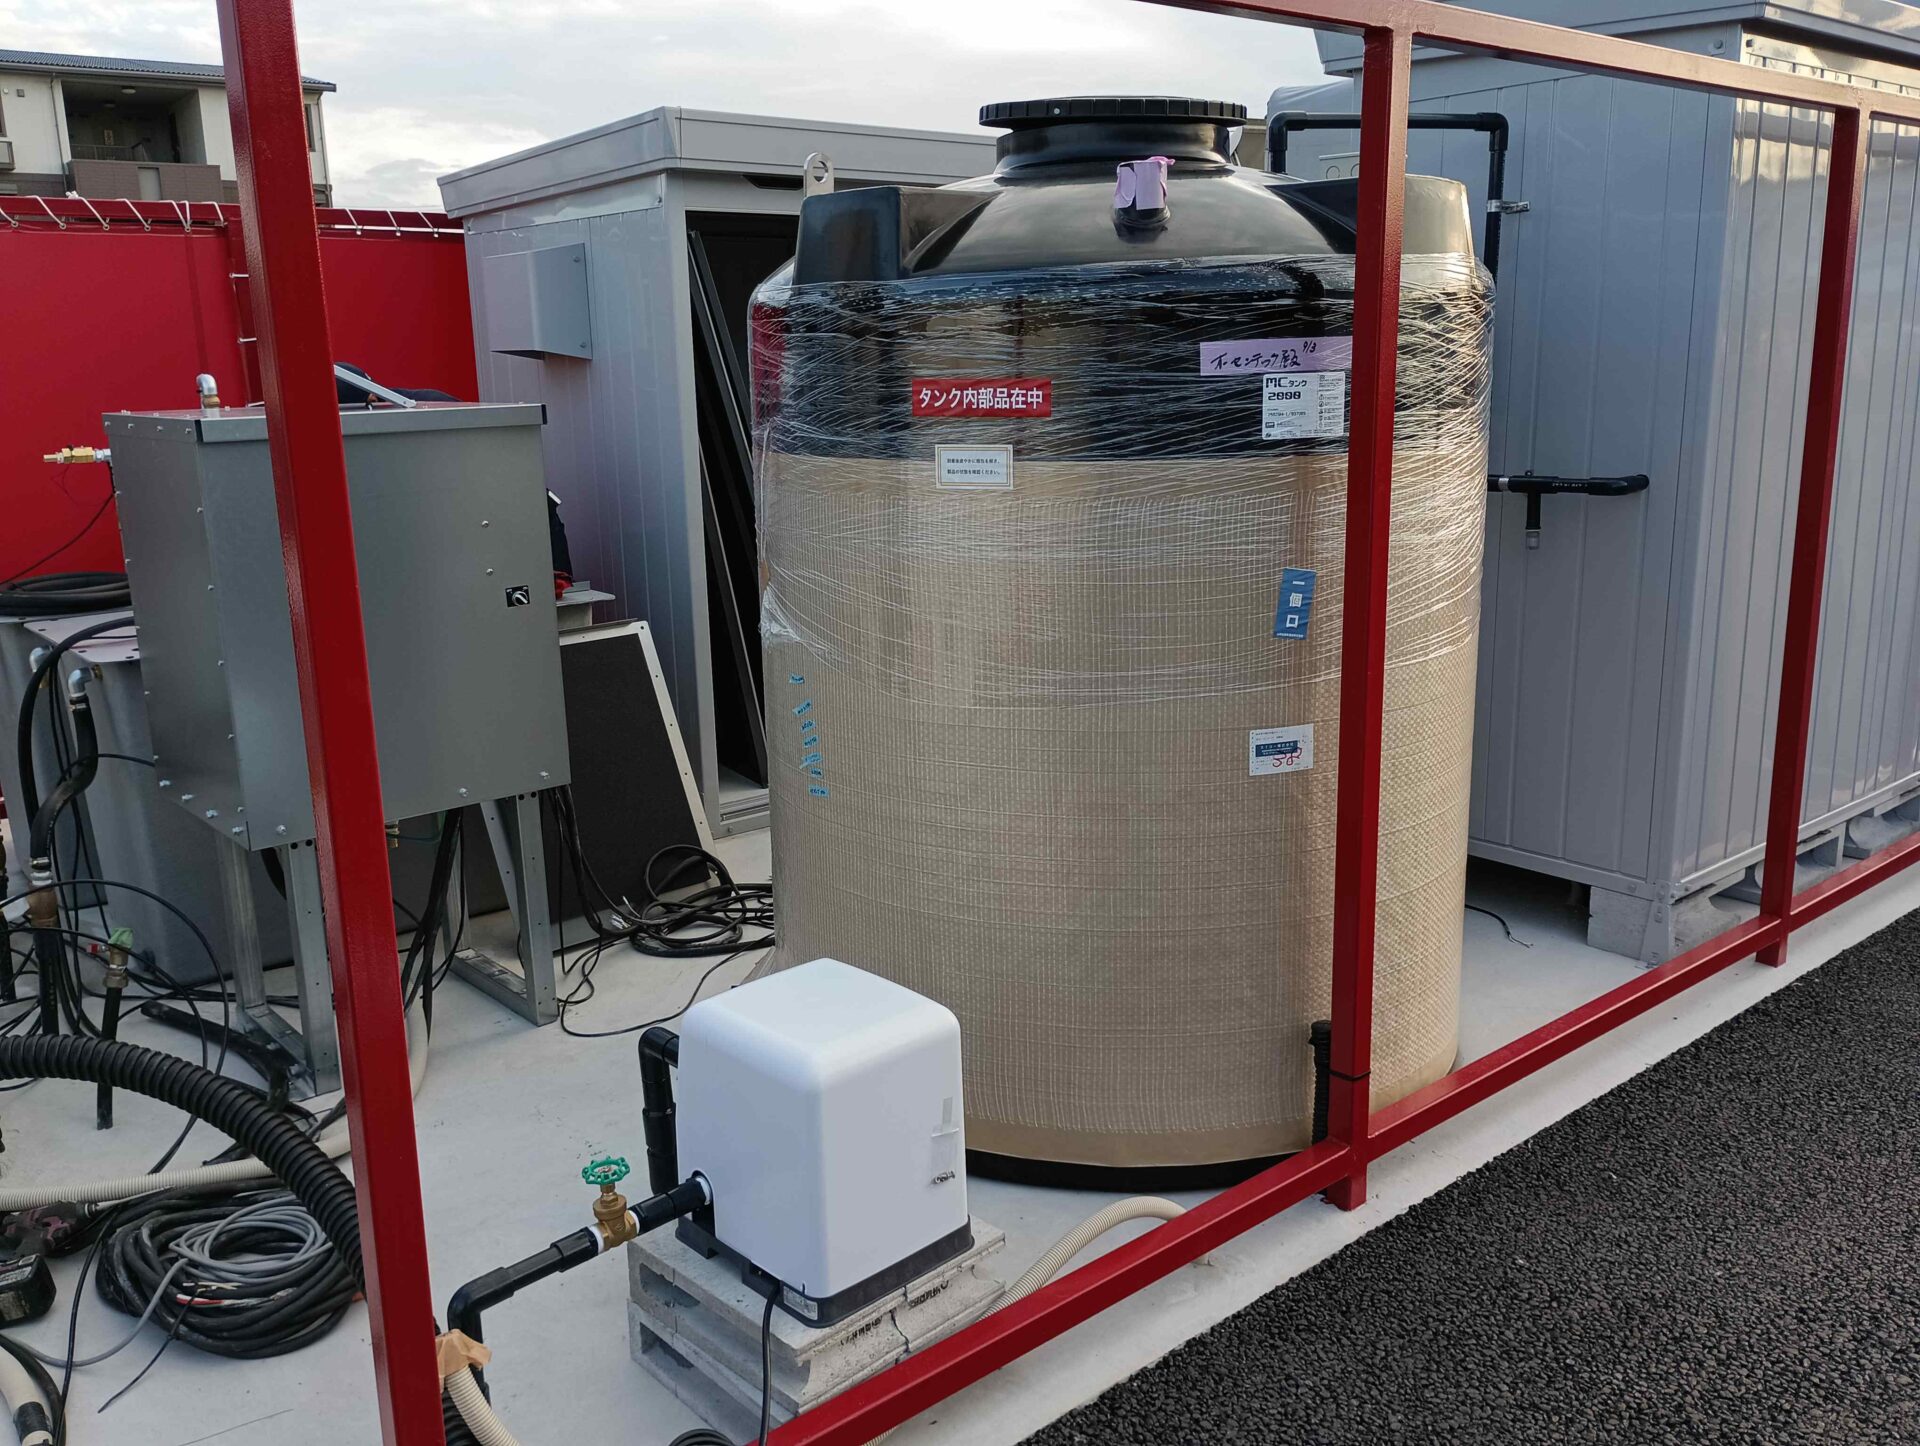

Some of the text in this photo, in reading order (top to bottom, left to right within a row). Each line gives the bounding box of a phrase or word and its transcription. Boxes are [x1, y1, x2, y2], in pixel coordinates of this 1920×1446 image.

[919, 386, 1043, 410] タンク内部品在中
[1267, 391, 1302, 401] 2000
